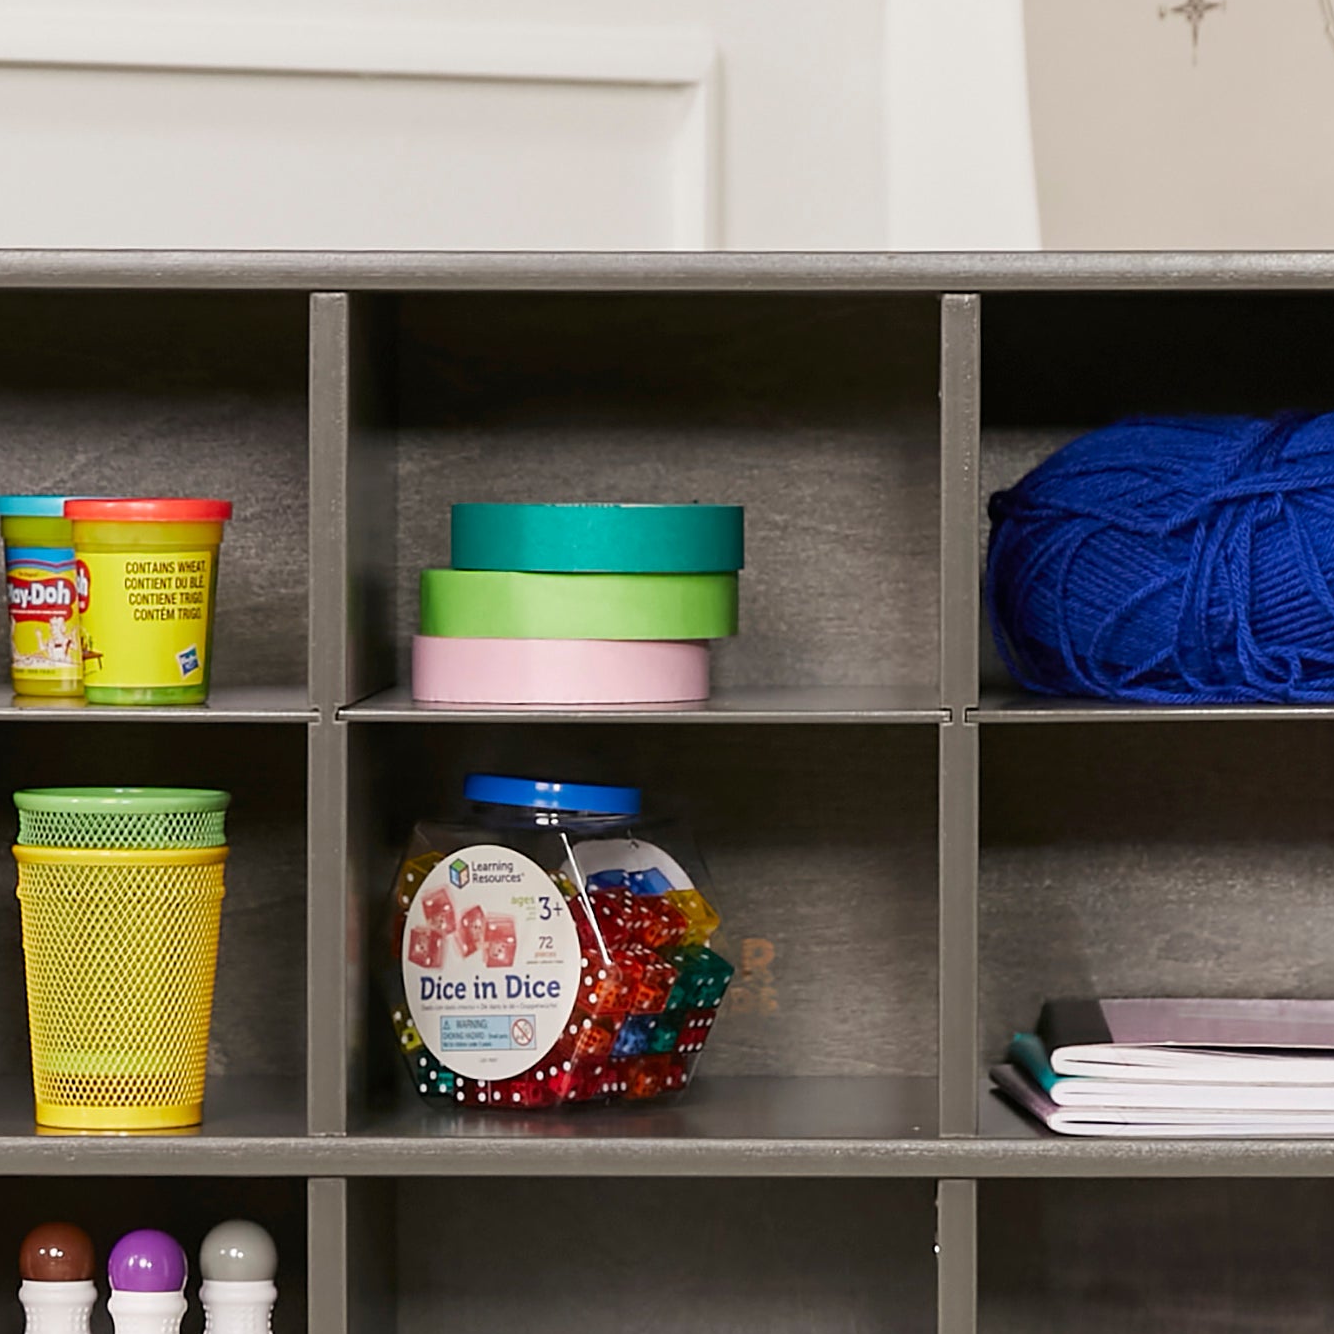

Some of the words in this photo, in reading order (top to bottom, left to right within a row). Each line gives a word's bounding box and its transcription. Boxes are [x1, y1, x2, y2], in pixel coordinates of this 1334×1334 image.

[125, 561, 175, 574] CONTAINS
[124, 577, 172, 589] CONTIENT
[175, 577, 187, 589] DU
[6, 580, 71, 609] lay-Doh
[129, 593, 177, 605] CONTIENE
[133, 607, 175, 621] CONTÉM
[471, 862, 513, 873] Learning
[511, 896, 535, 907] ages
[538, 896, 563, 920] 3+
[539, 936, 554, 949] 72
[420, 975, 466, 1000] Dice
[474, 975, 498, 999] in
[505, 974, 561, 999] Dice
